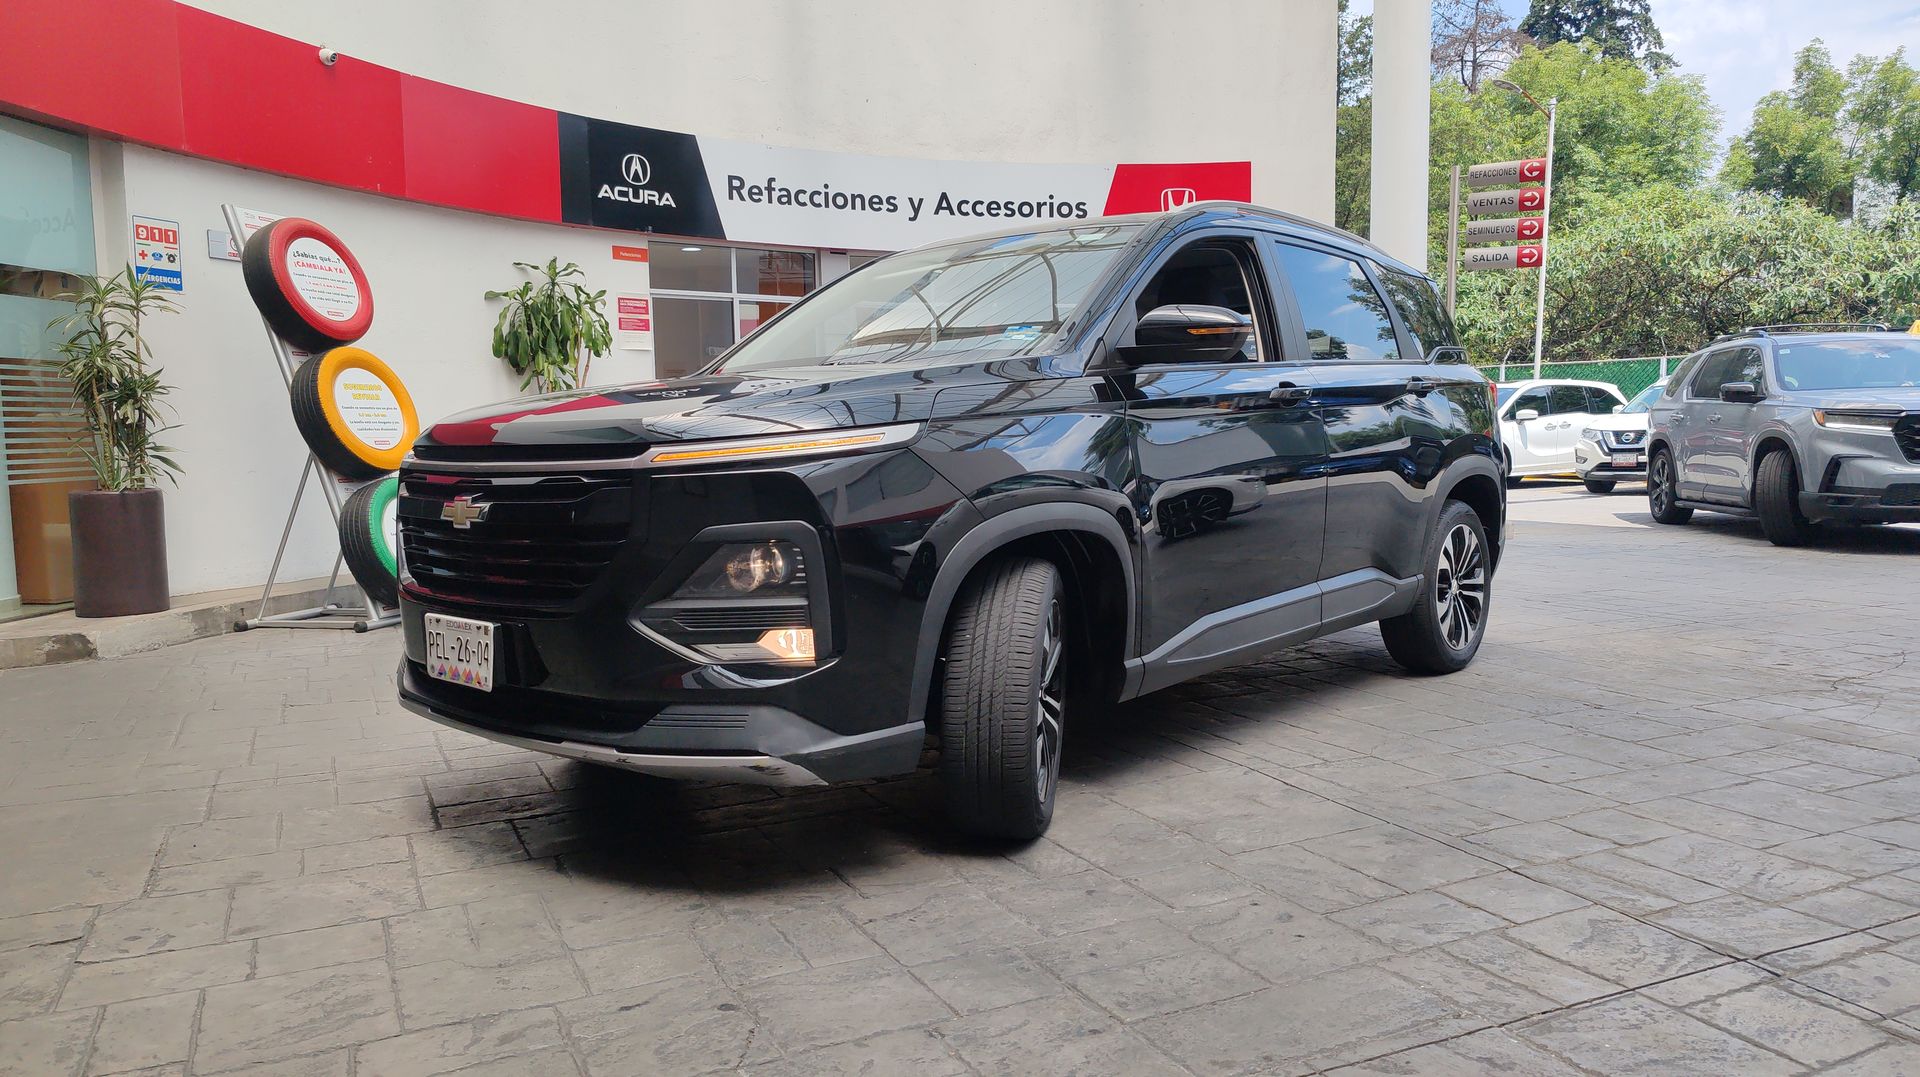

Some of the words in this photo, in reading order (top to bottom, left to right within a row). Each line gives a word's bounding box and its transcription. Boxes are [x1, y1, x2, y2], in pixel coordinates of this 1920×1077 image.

[1470, 167, 1517, 180] REFACCIONES
[597, 184, 677, 208] ACURA
[727, 174, 899, 213] Refacciones
[907, 197, 924, 222] y
[933, 191, 1088, 219] Accesorios
[1473, 196, 1514, 208] VENTAS
[138, 227, 174, 243] 911
[1468, 224, 1516, 236] SEMINUEVOS
[1472, 253, 1510, 263] SALIDA
